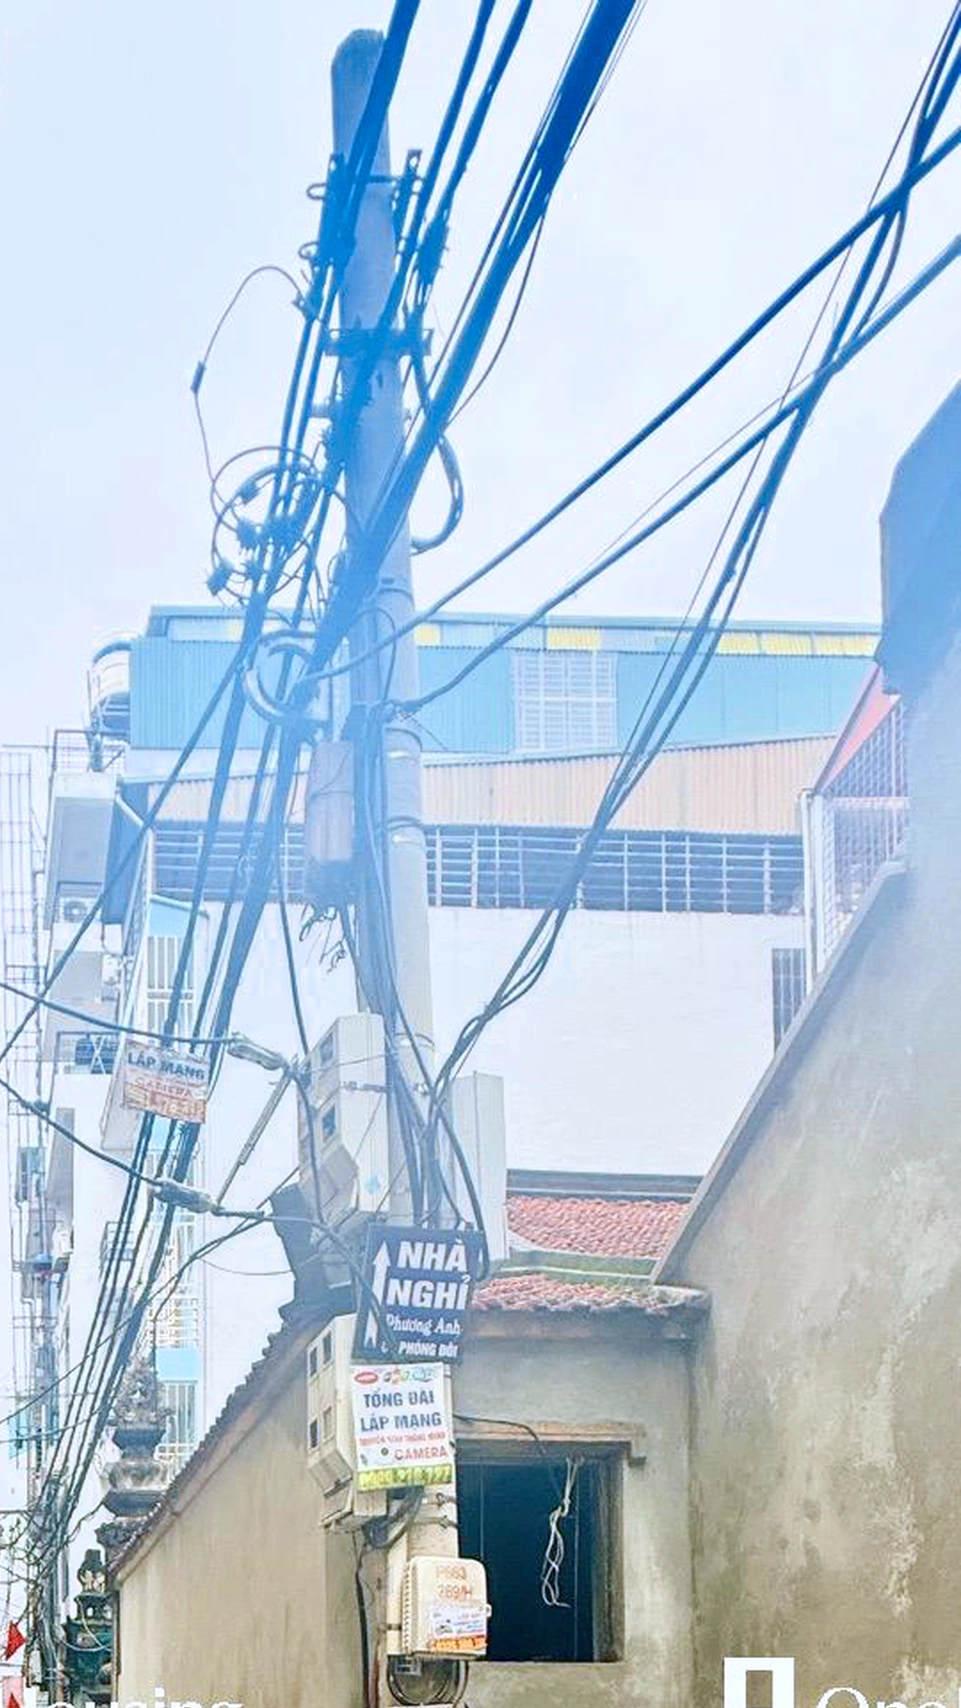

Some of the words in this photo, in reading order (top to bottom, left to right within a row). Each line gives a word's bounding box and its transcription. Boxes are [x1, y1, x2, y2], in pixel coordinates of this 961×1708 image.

[397, 1238, 468, 1272] NHÀ
[386, 1275, 471, 1310] NGHỈ
[433, 1317, 461, 1335] Anh
[394, 1412, 442, 1431] MẠNG
[394, 1445, 449, 1460] CAMERA
